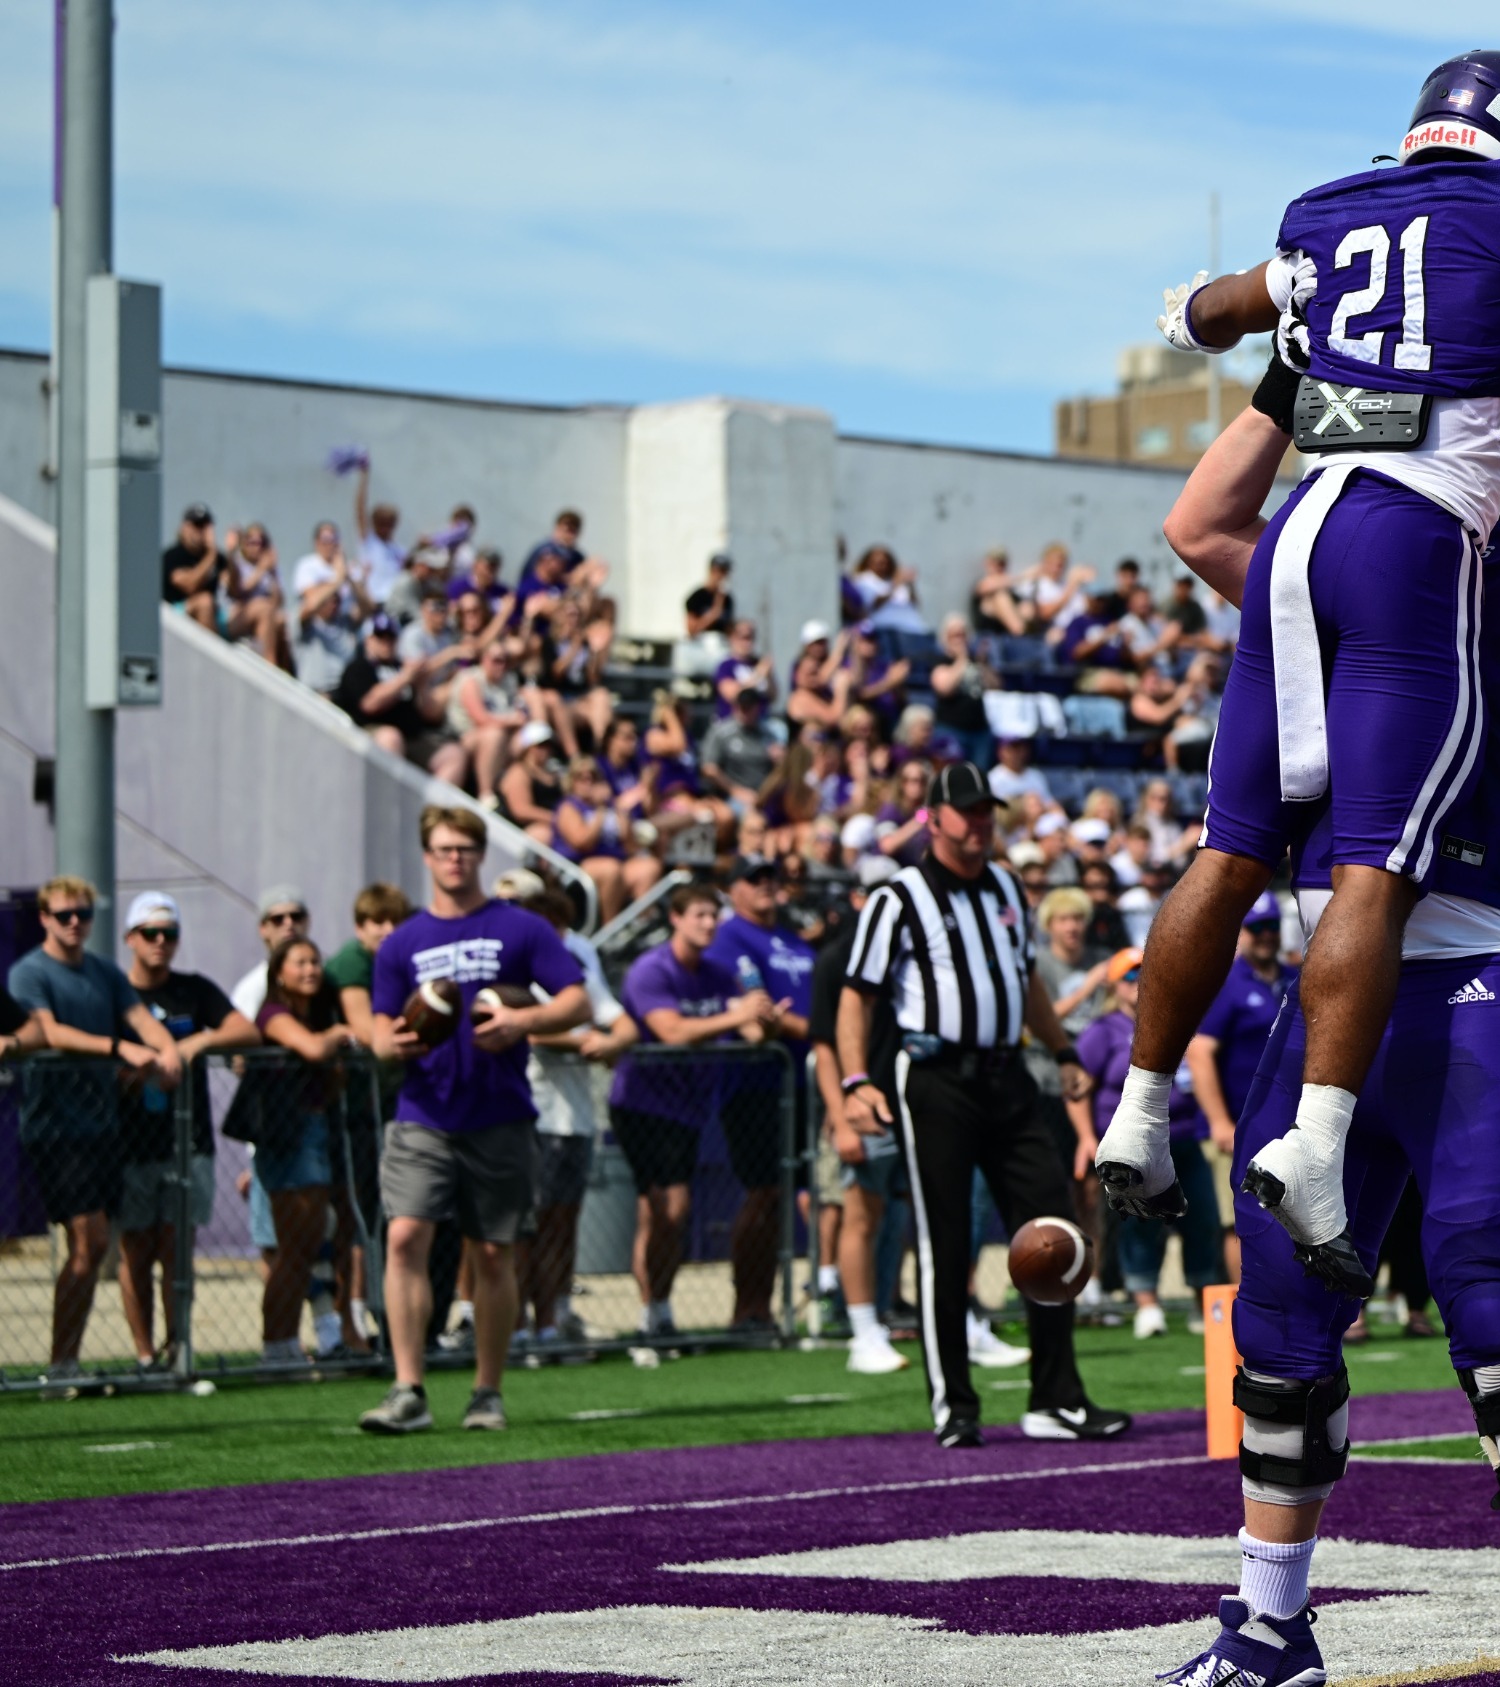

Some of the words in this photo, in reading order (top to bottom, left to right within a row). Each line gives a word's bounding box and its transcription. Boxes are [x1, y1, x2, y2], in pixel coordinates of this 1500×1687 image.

[1404, 126, 1477, 150] Riddell
[1327, 215, 1432, 371] 21
[1447, 991, 1496, 1005] adidas
